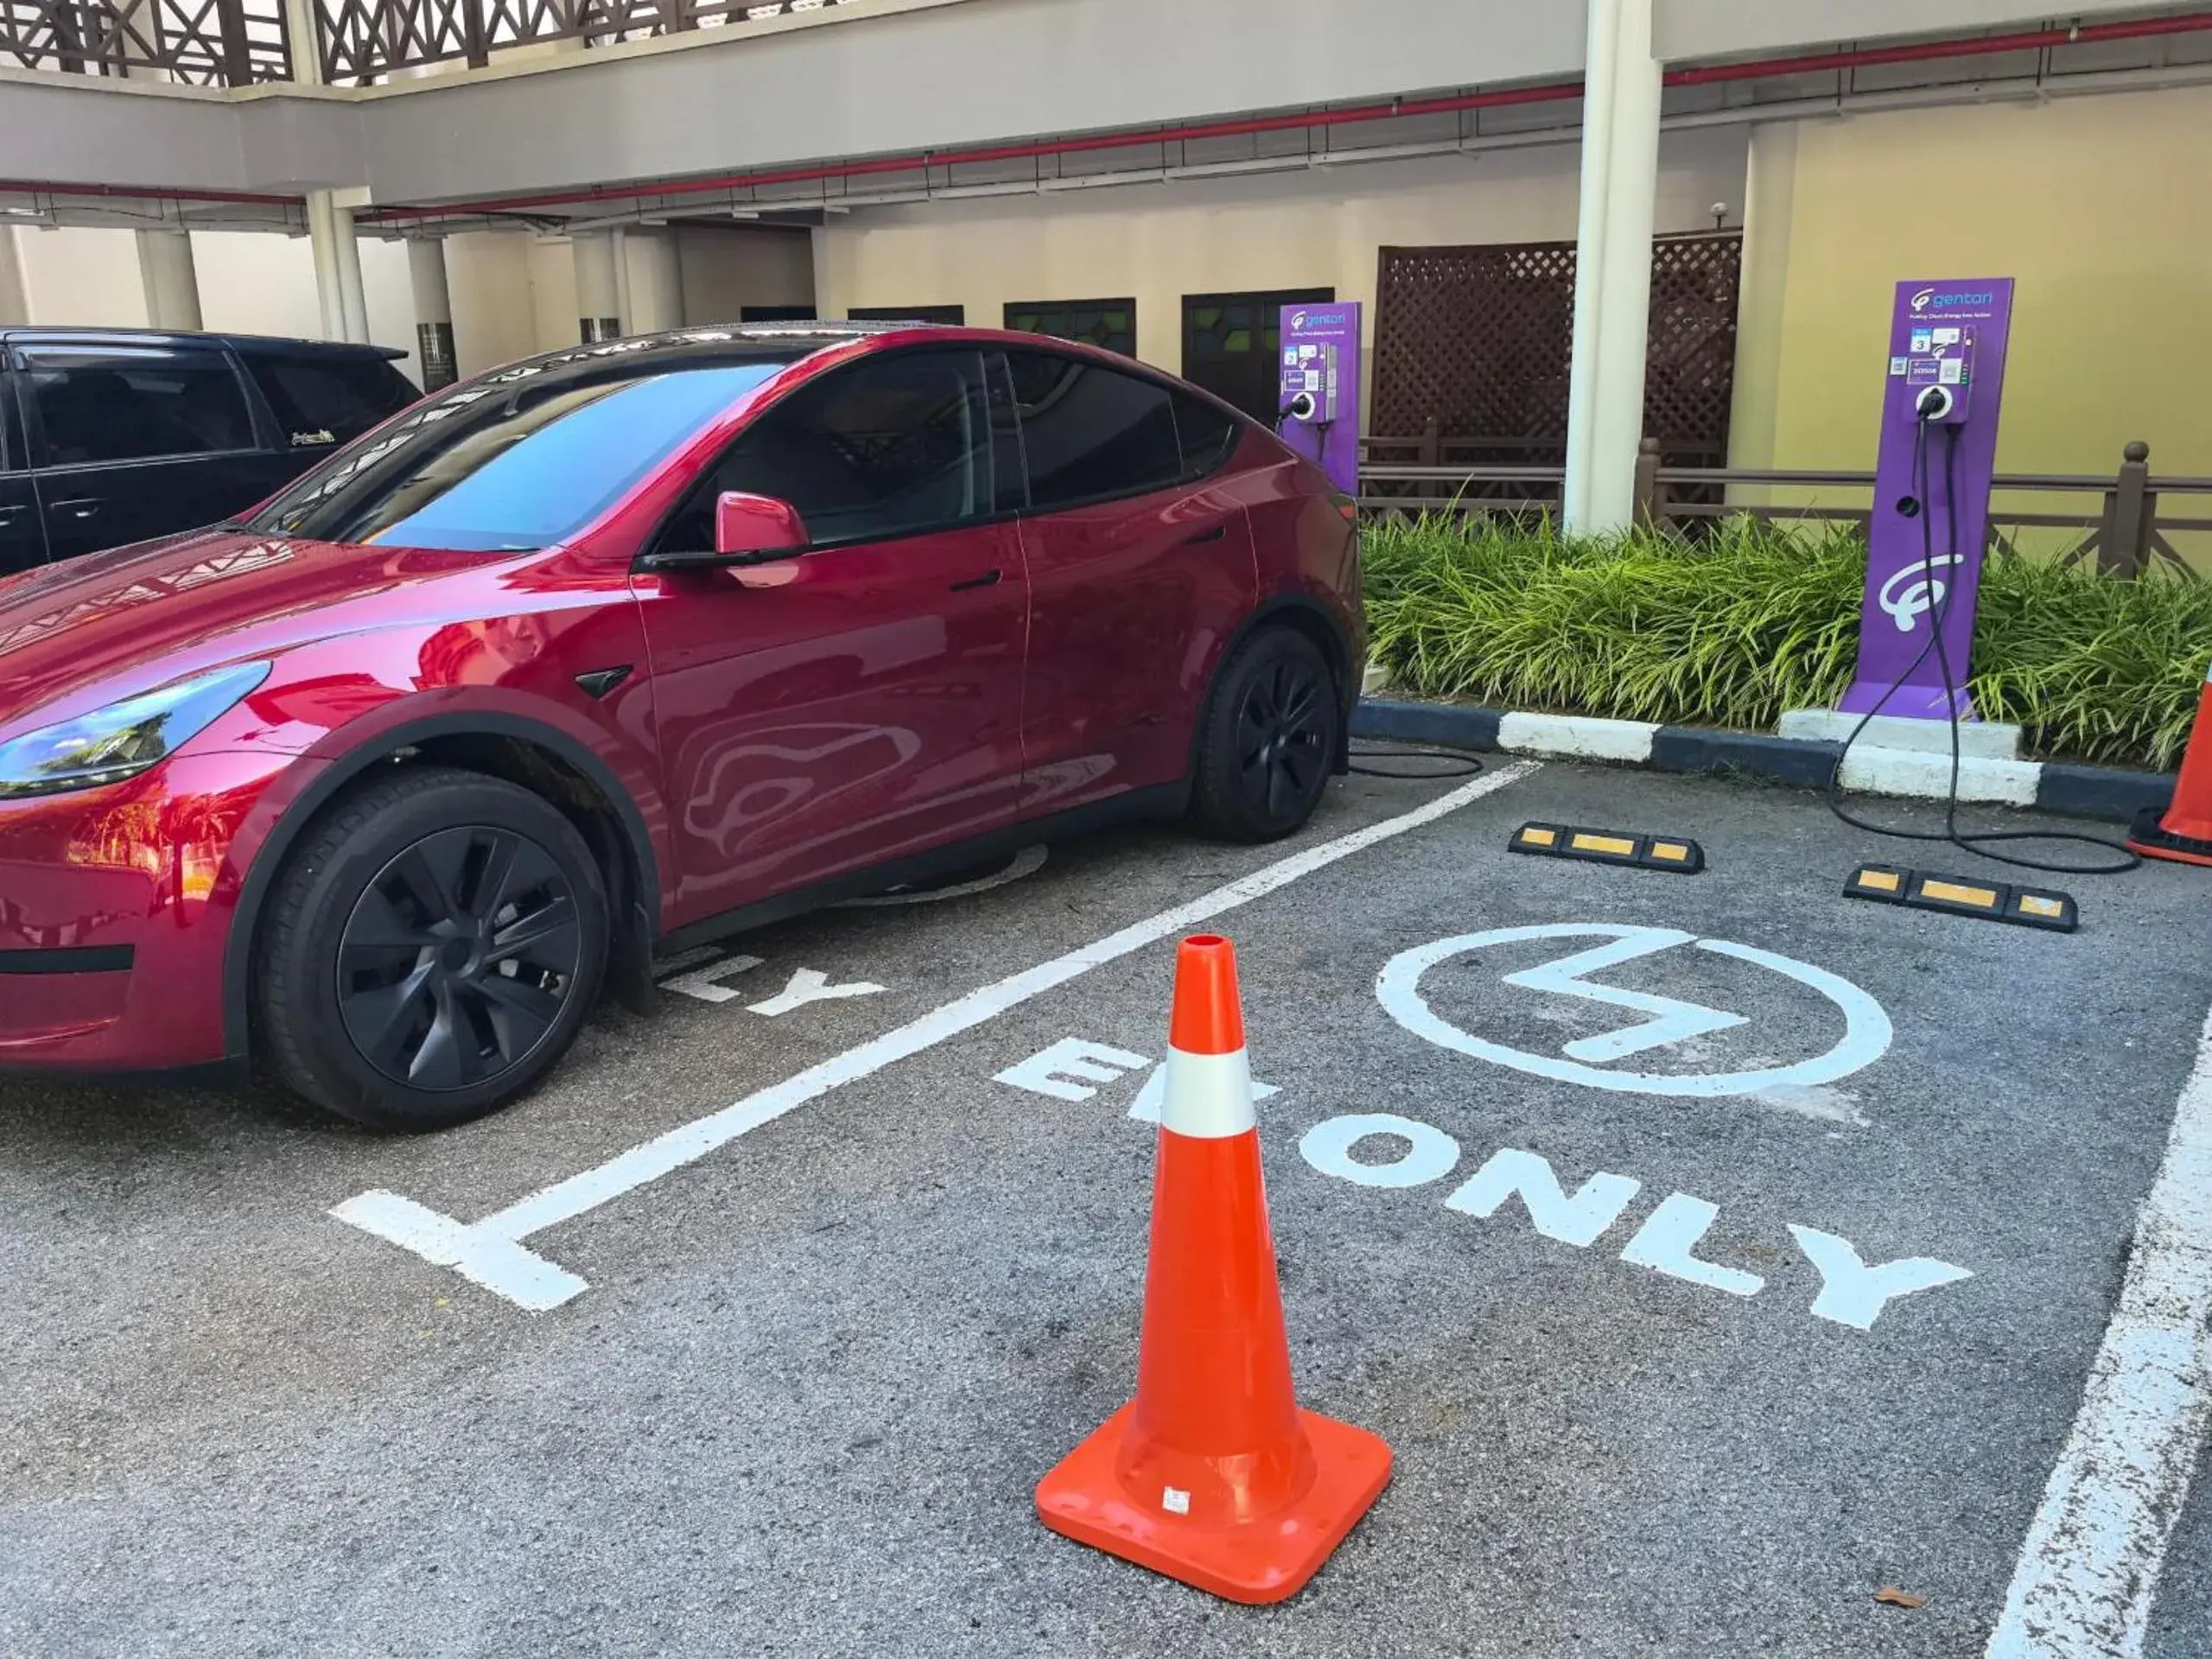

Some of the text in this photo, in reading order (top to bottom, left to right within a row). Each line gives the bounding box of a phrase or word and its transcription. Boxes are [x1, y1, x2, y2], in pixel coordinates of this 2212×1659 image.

[1933, 292, 1993, 308] gentari
[653, 947, 889, 1016] LY
[1299, 1113, 1974, 1330] ONLY
